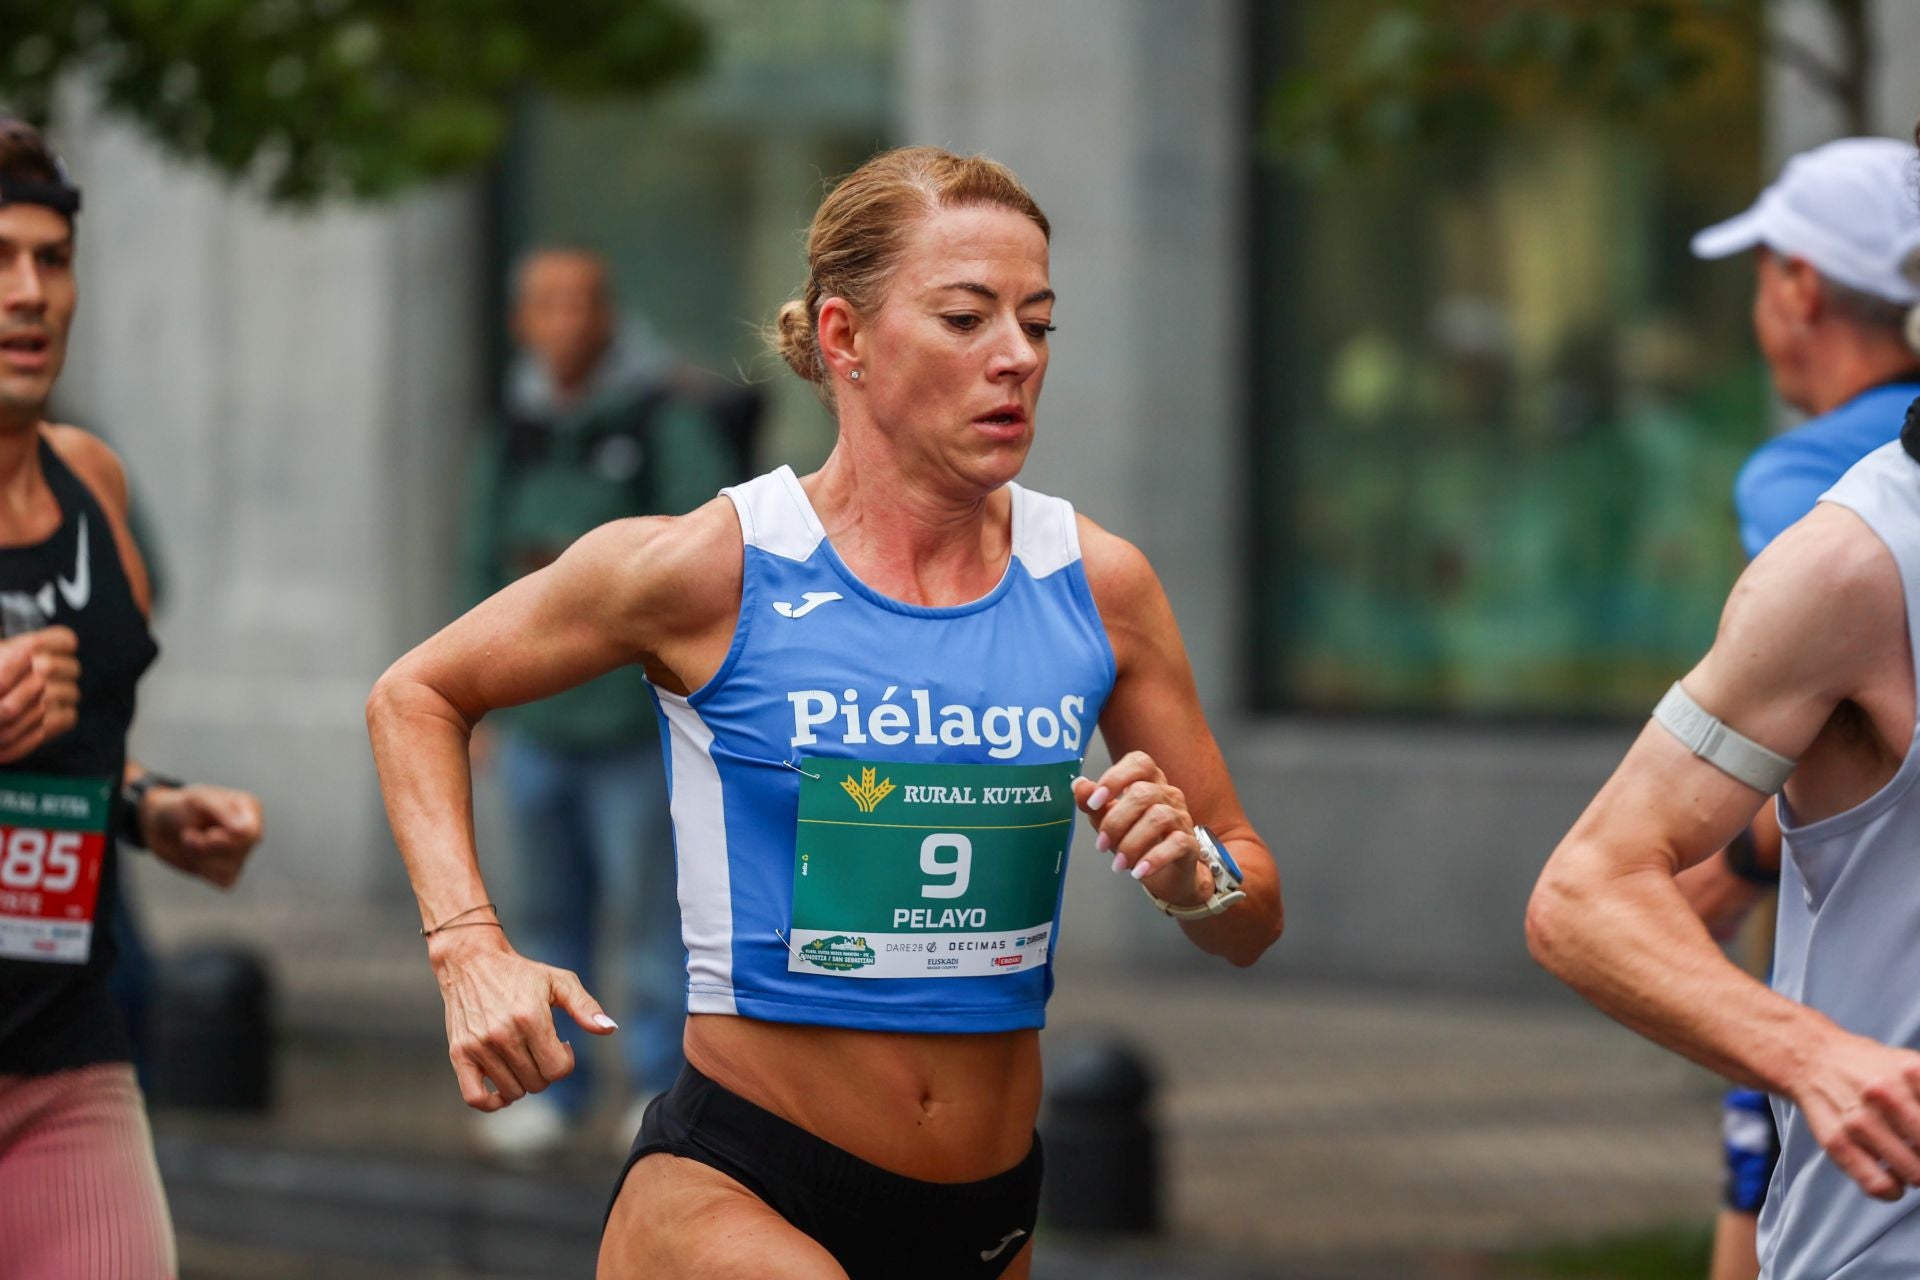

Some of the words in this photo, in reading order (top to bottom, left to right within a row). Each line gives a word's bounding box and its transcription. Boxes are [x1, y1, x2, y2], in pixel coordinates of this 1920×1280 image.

[903, 785, 977, 804] RURAL
[982, 785, 1052, 805] KUTXA
[0, 828, 82, 892] 85
[919, 833, 973, 899] 9
[892, 907, 987, 929] PELAYO
[949, 941, 1006, 951] DECIMAS
[927, 958, 959, 966] EUSKADI
